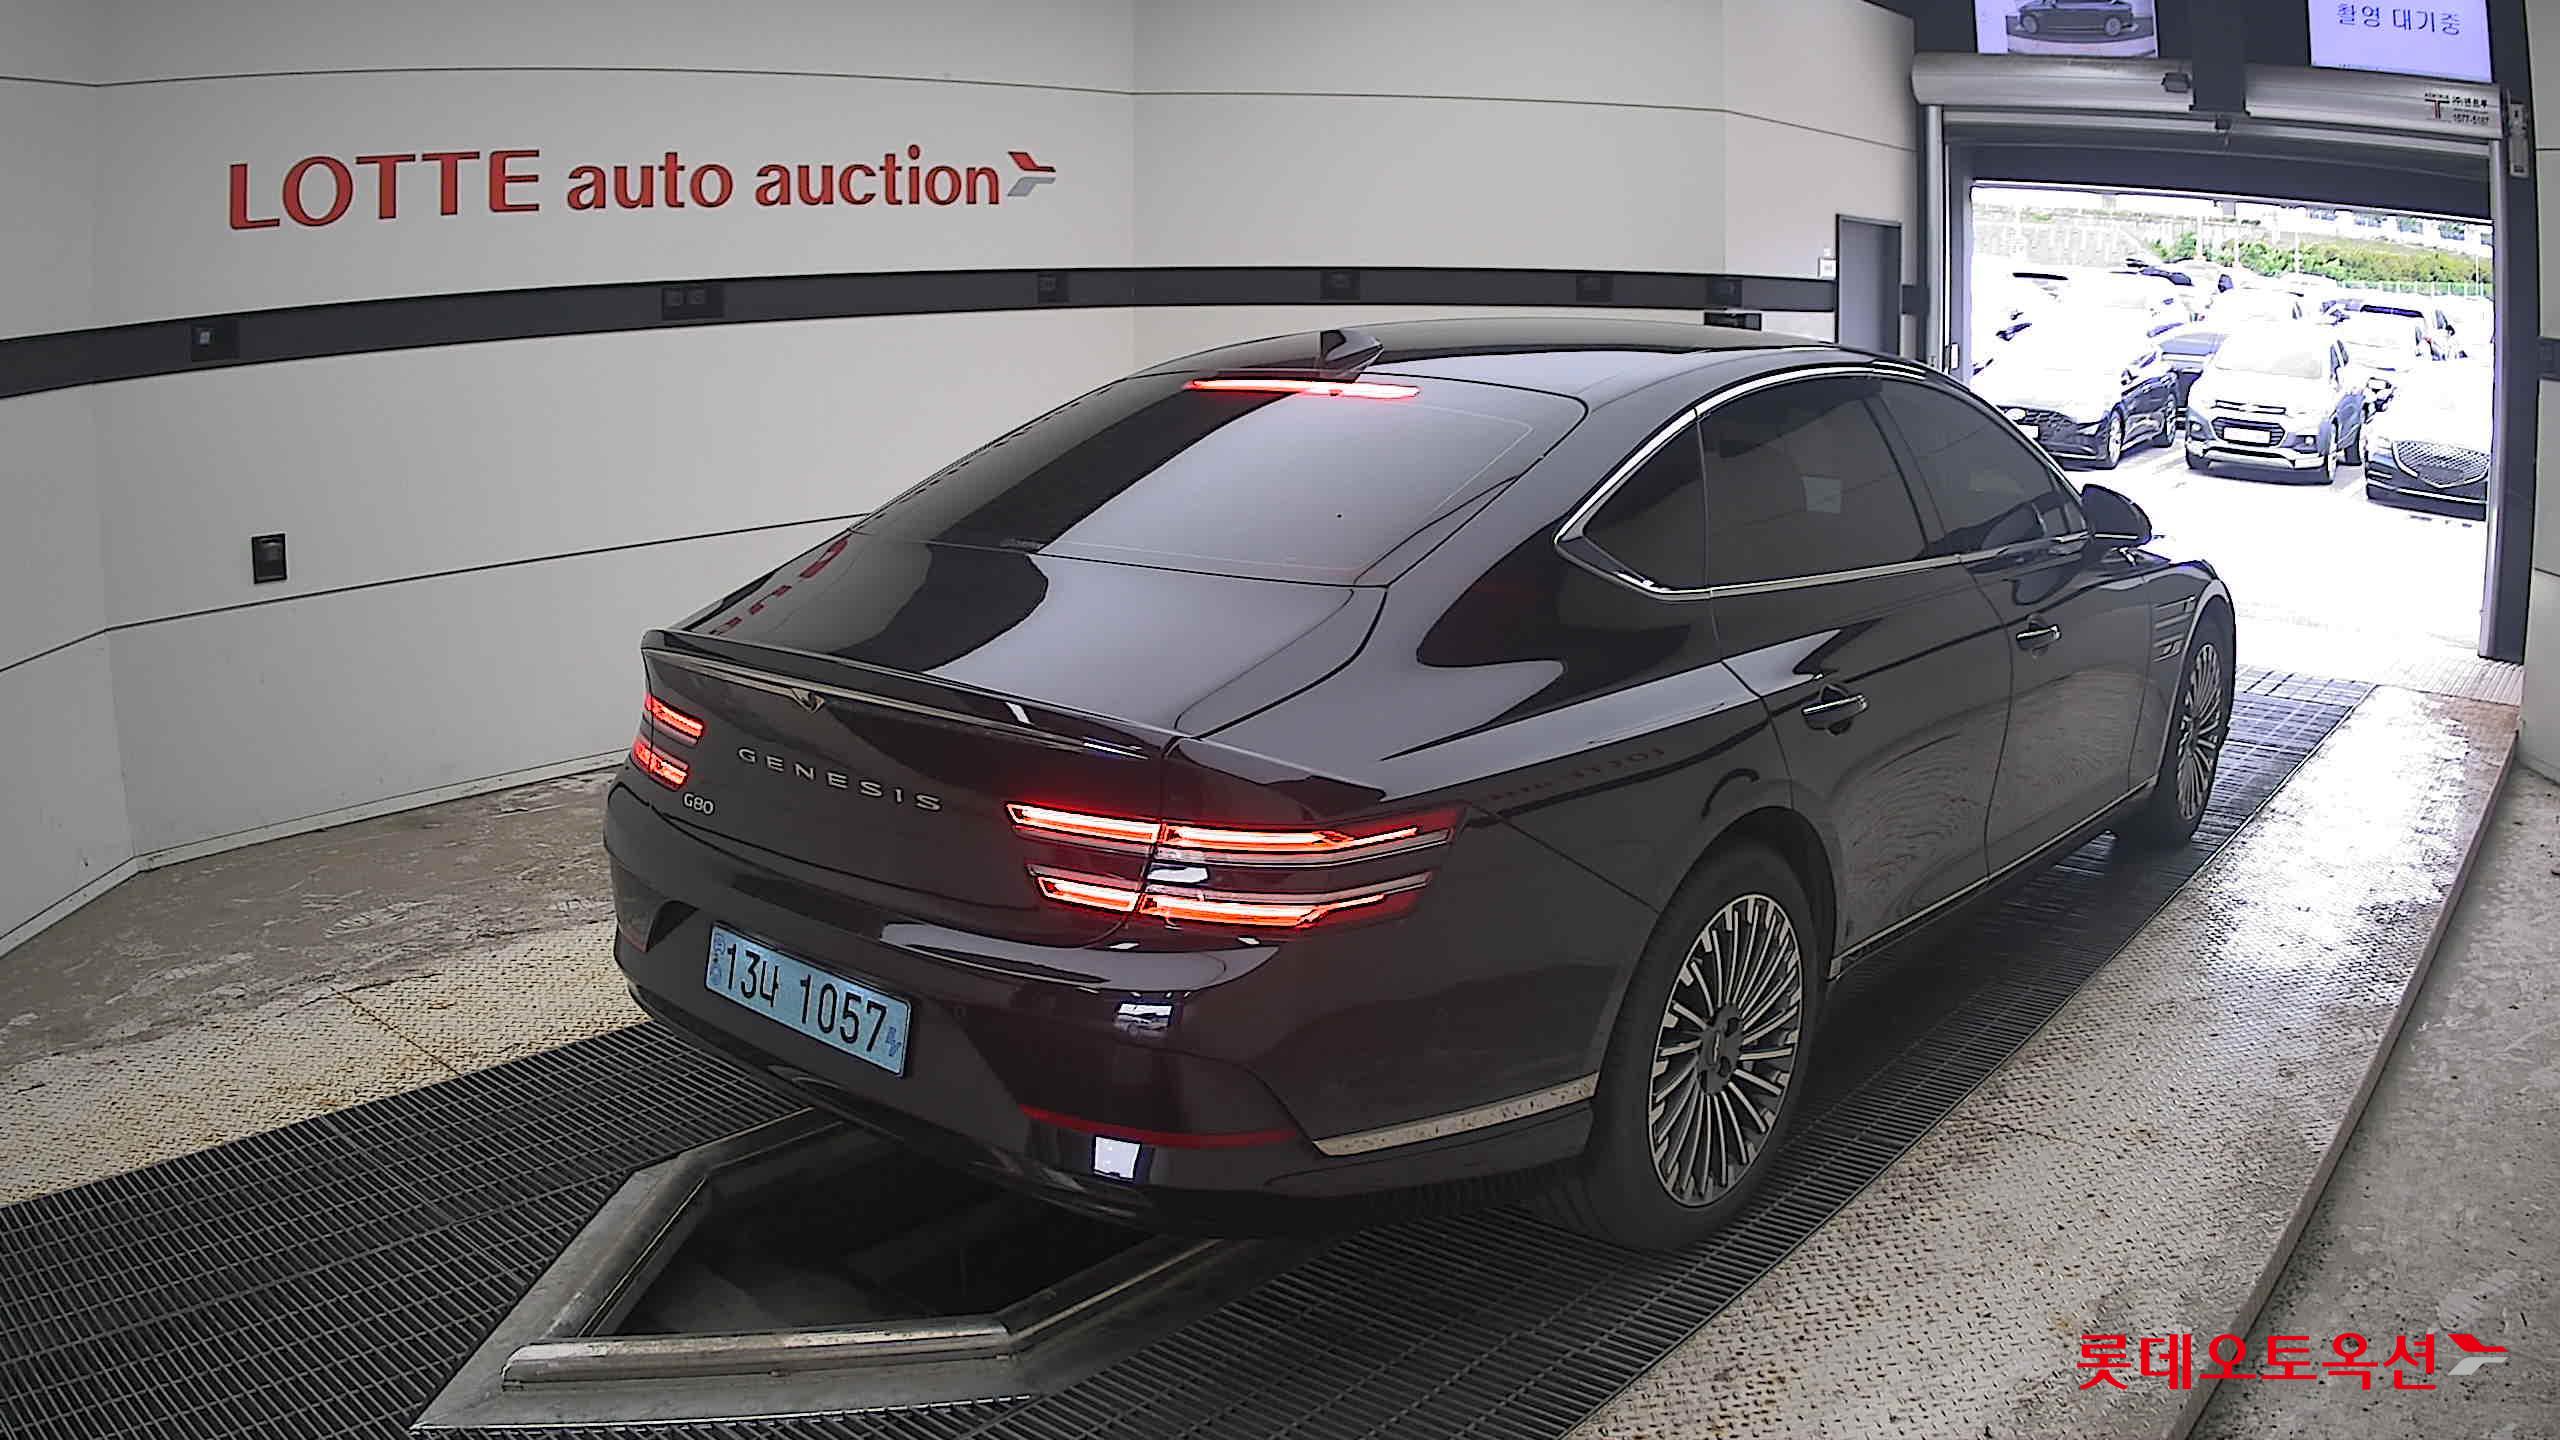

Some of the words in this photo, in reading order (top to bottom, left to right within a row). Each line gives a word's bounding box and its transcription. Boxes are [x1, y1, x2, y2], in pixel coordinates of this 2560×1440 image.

[2337, 3, 2381, 28] 촬영
[229, 149, 540, 231] LOTTE
[567, 152, 736, 210] auto
[754, 144, 1003, 207] auction
[683, 792, 715, 815] G80
[737, 747, 943, 812] GENESIS
[800, 973, 888, 1052] 1057
